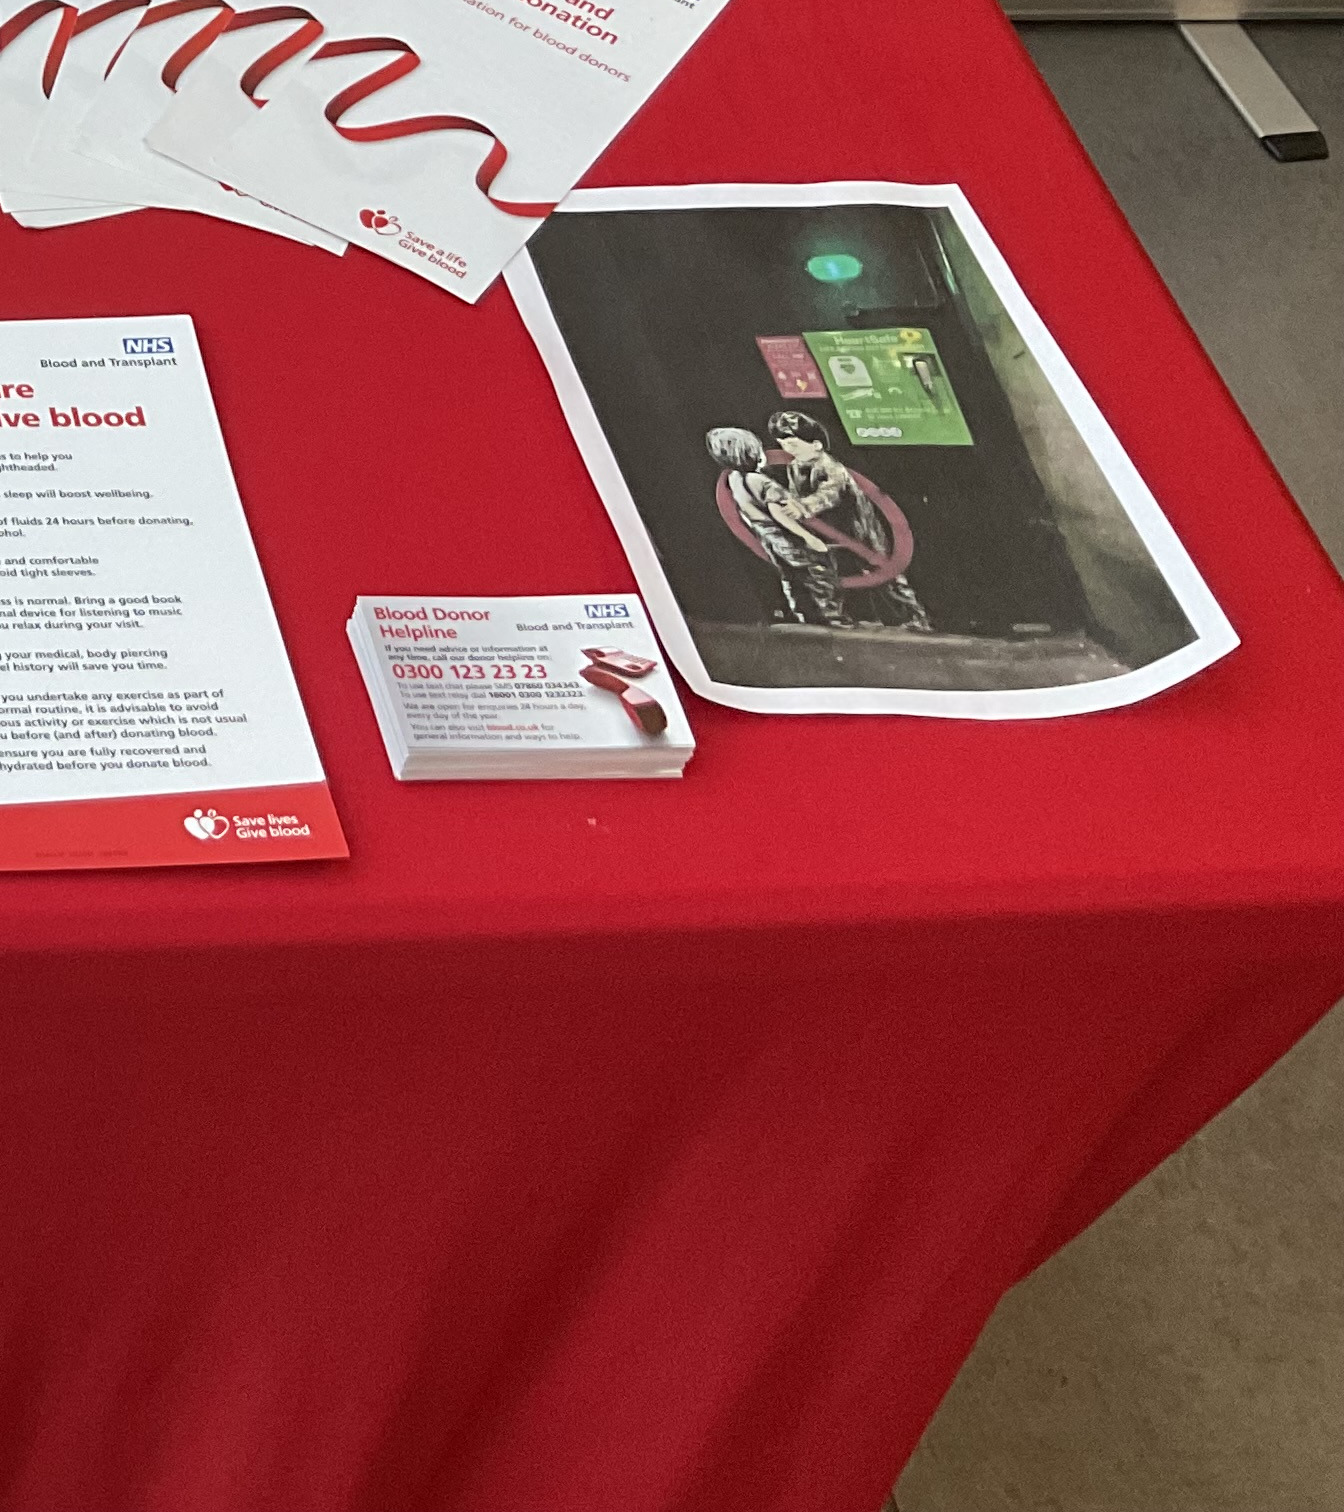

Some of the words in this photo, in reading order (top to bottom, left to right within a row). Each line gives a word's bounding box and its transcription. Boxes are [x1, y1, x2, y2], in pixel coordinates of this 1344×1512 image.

[508, 16, 531, 31] for
[532, 28, 577, 55] blood
[578, 53, 630, 82] donors
[123, 337, 172, 353] NHS
[39, 358, 77, 367] Blood
[81, 357, 105, 367] and
[108, 356, 177, 368] Transplant
[48, 406, 146, 427] blood
[374, 606, 427, 620] Blood
[432, 607, 489, 620] Donor
[379, 624, 457, 641] Helpline
